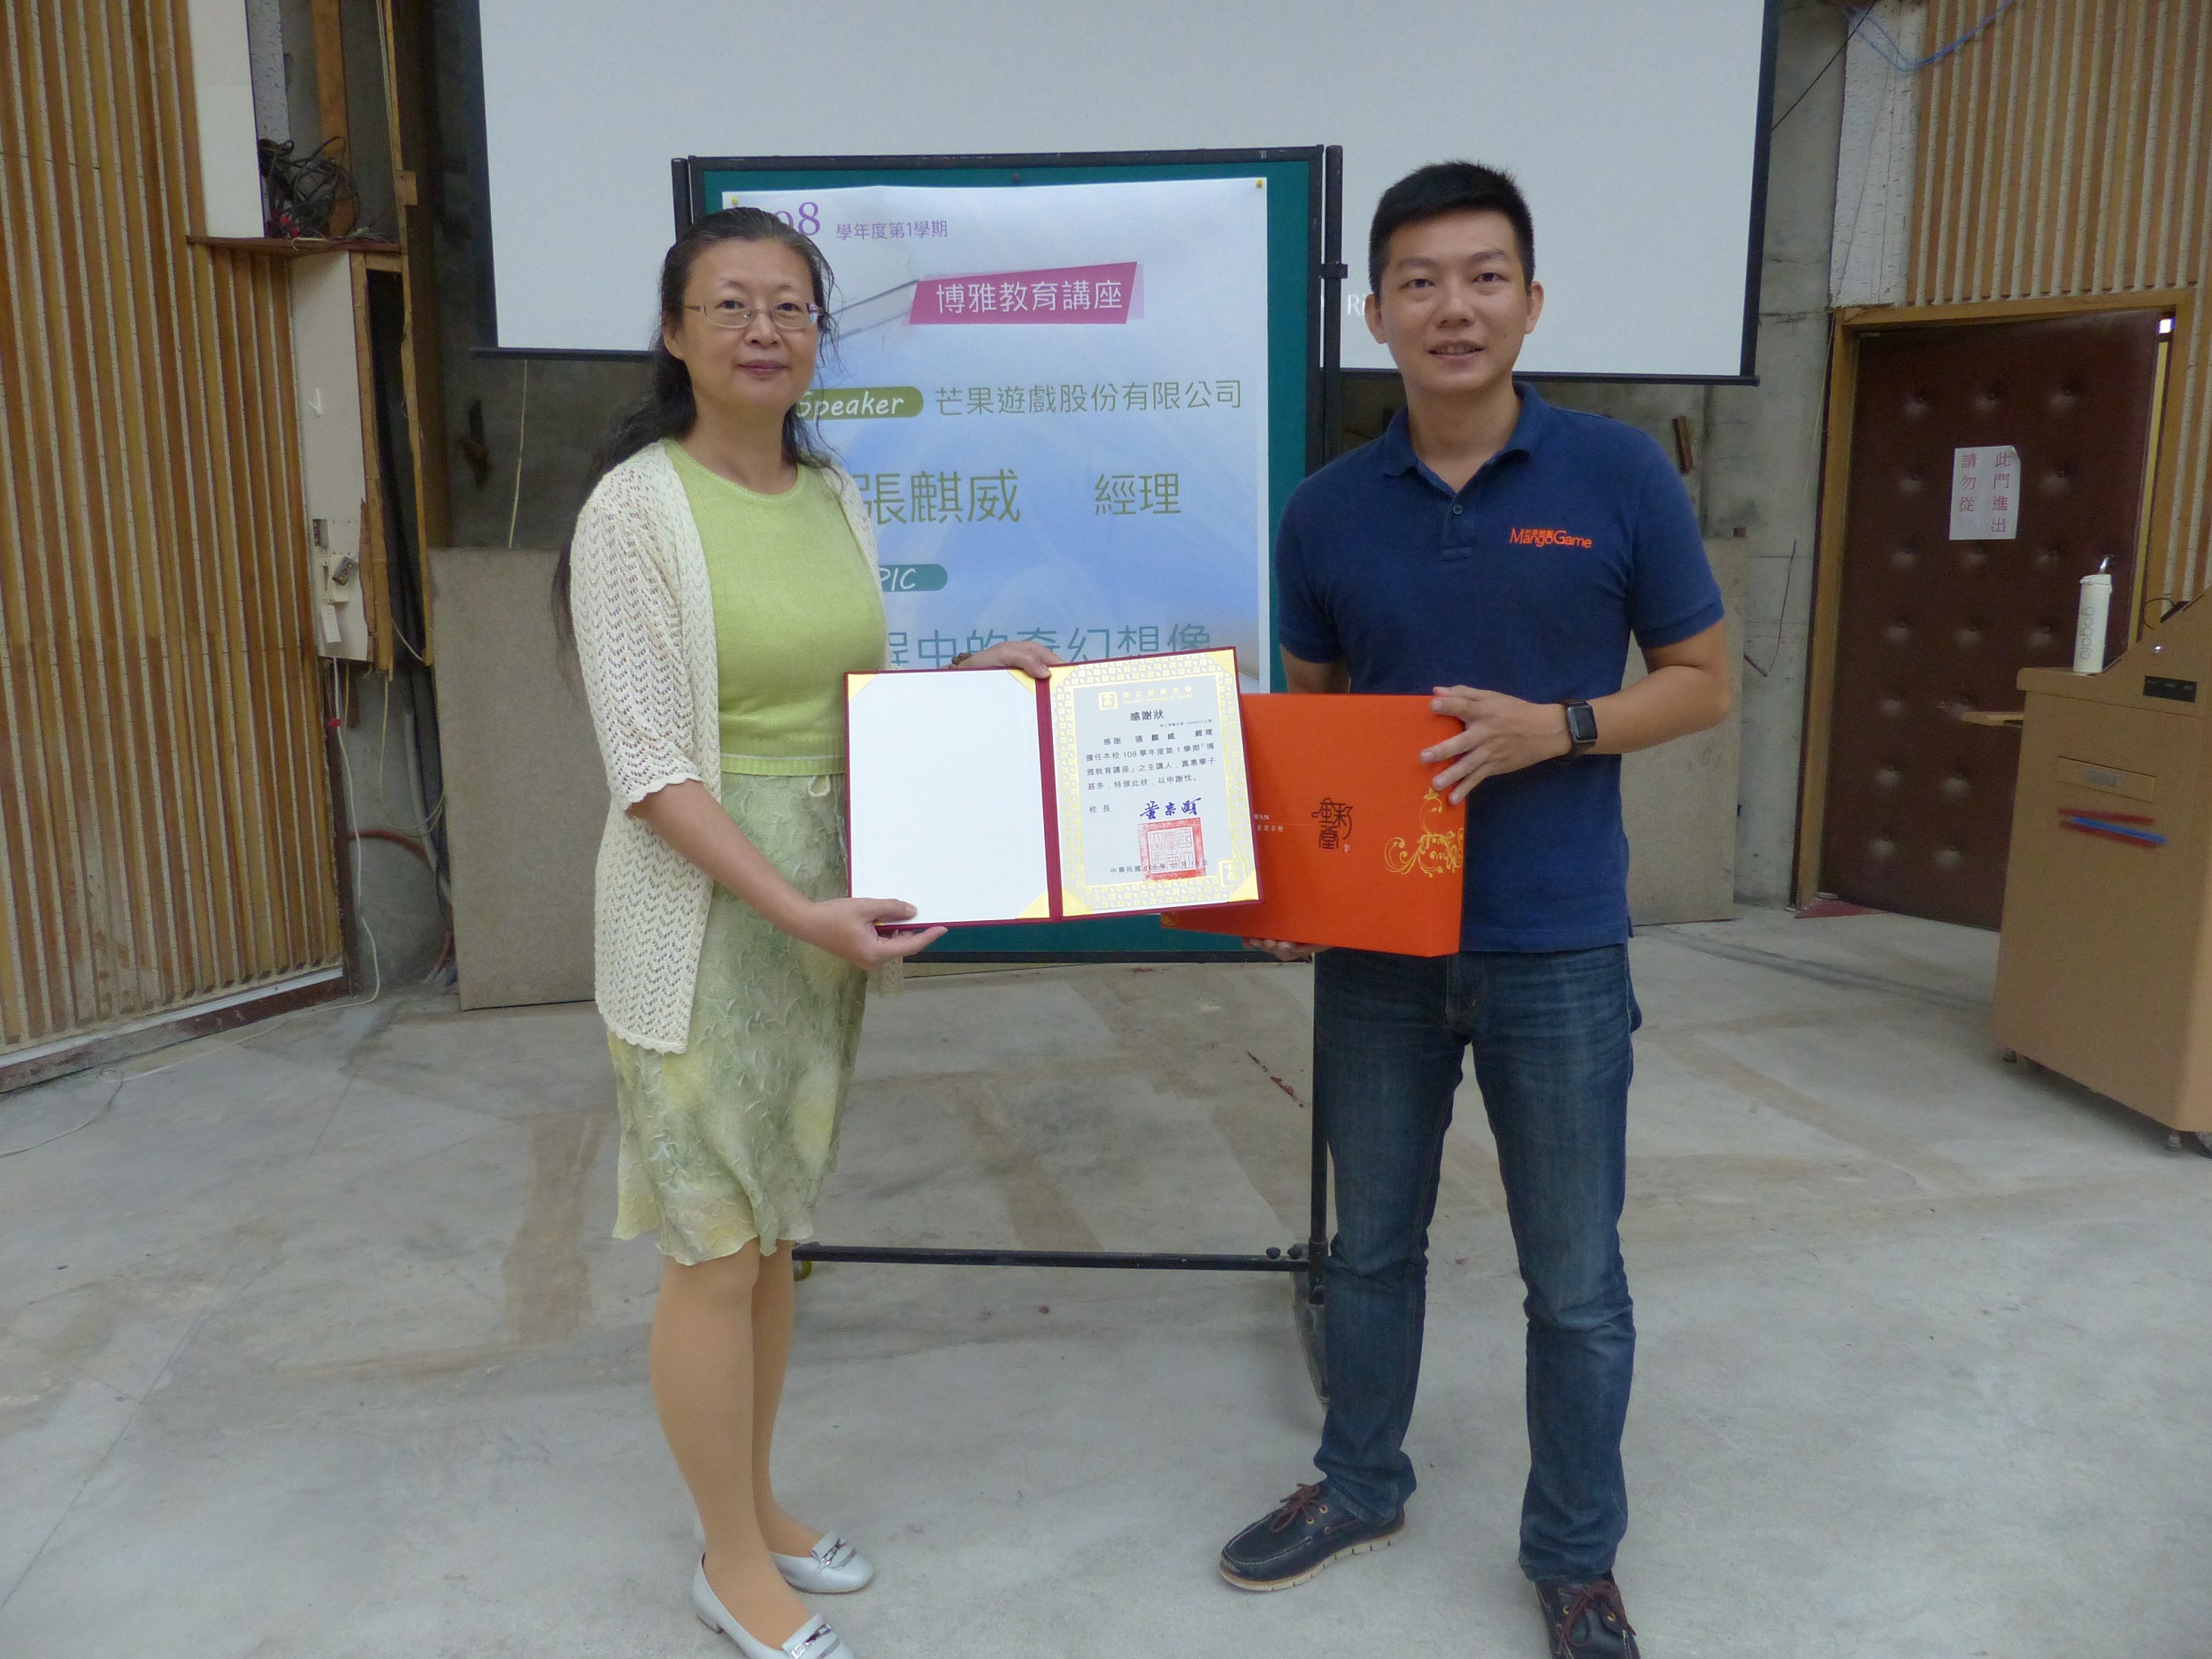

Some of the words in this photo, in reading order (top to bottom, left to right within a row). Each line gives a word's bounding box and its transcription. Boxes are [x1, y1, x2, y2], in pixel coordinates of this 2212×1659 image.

[836, 220, 948, 242] 學年度第1學期
[936, 280, 1123, 315] 博雅教育講座
[795, 390, 905, 423] Speaker
[934, 380, 1241, 416] 芒果遊戲股份有限公司
[852, 468, 1021, 526] 張麒威
[1094, 472, 1181, 517] 經理
[1959, 452, 1978, 512] 請勿從
[1991, 450, 2012, 533] 此門進出
[1509, 527, 1593, 548] MangoGame
[1130, 709, 1164, 721] 感謝狀
[1194, 728, 1213, 738] 經理
[1089, 804, 1111, 814] 校長
